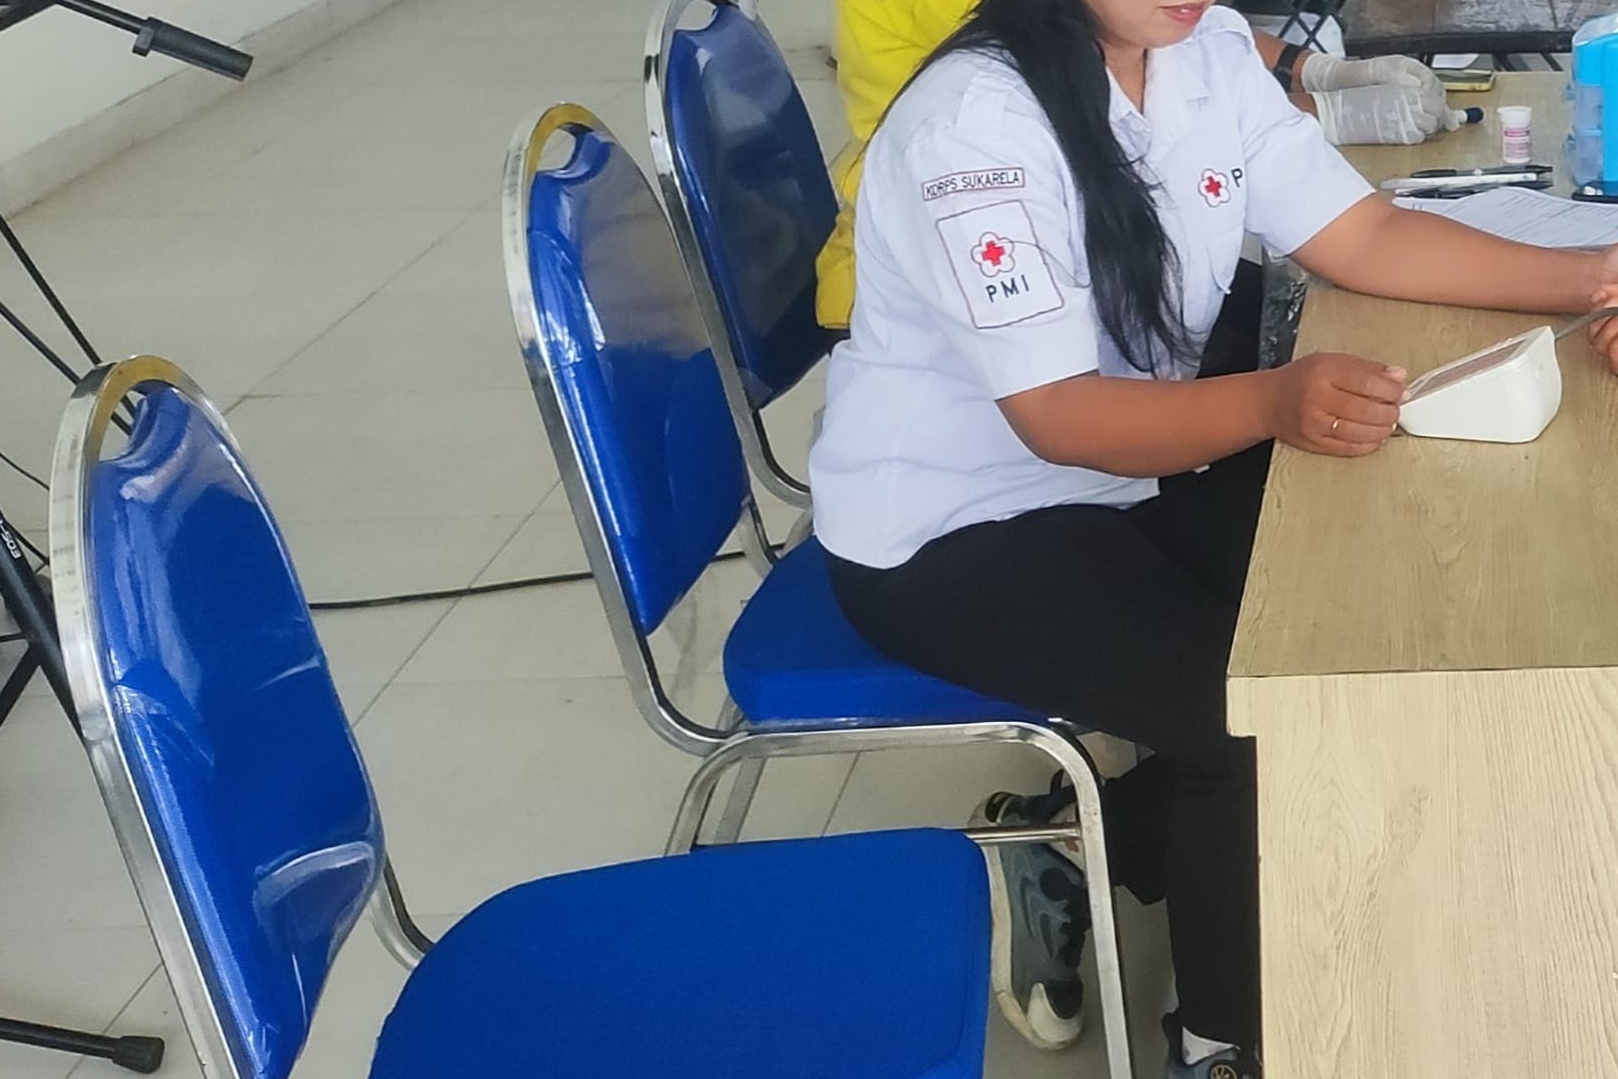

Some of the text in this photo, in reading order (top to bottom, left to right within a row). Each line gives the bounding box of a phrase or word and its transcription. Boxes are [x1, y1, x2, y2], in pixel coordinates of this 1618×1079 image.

[925, 171, 1019, 198] KORPS SUKARELA
[985, 274, 1030, 303] PMI
